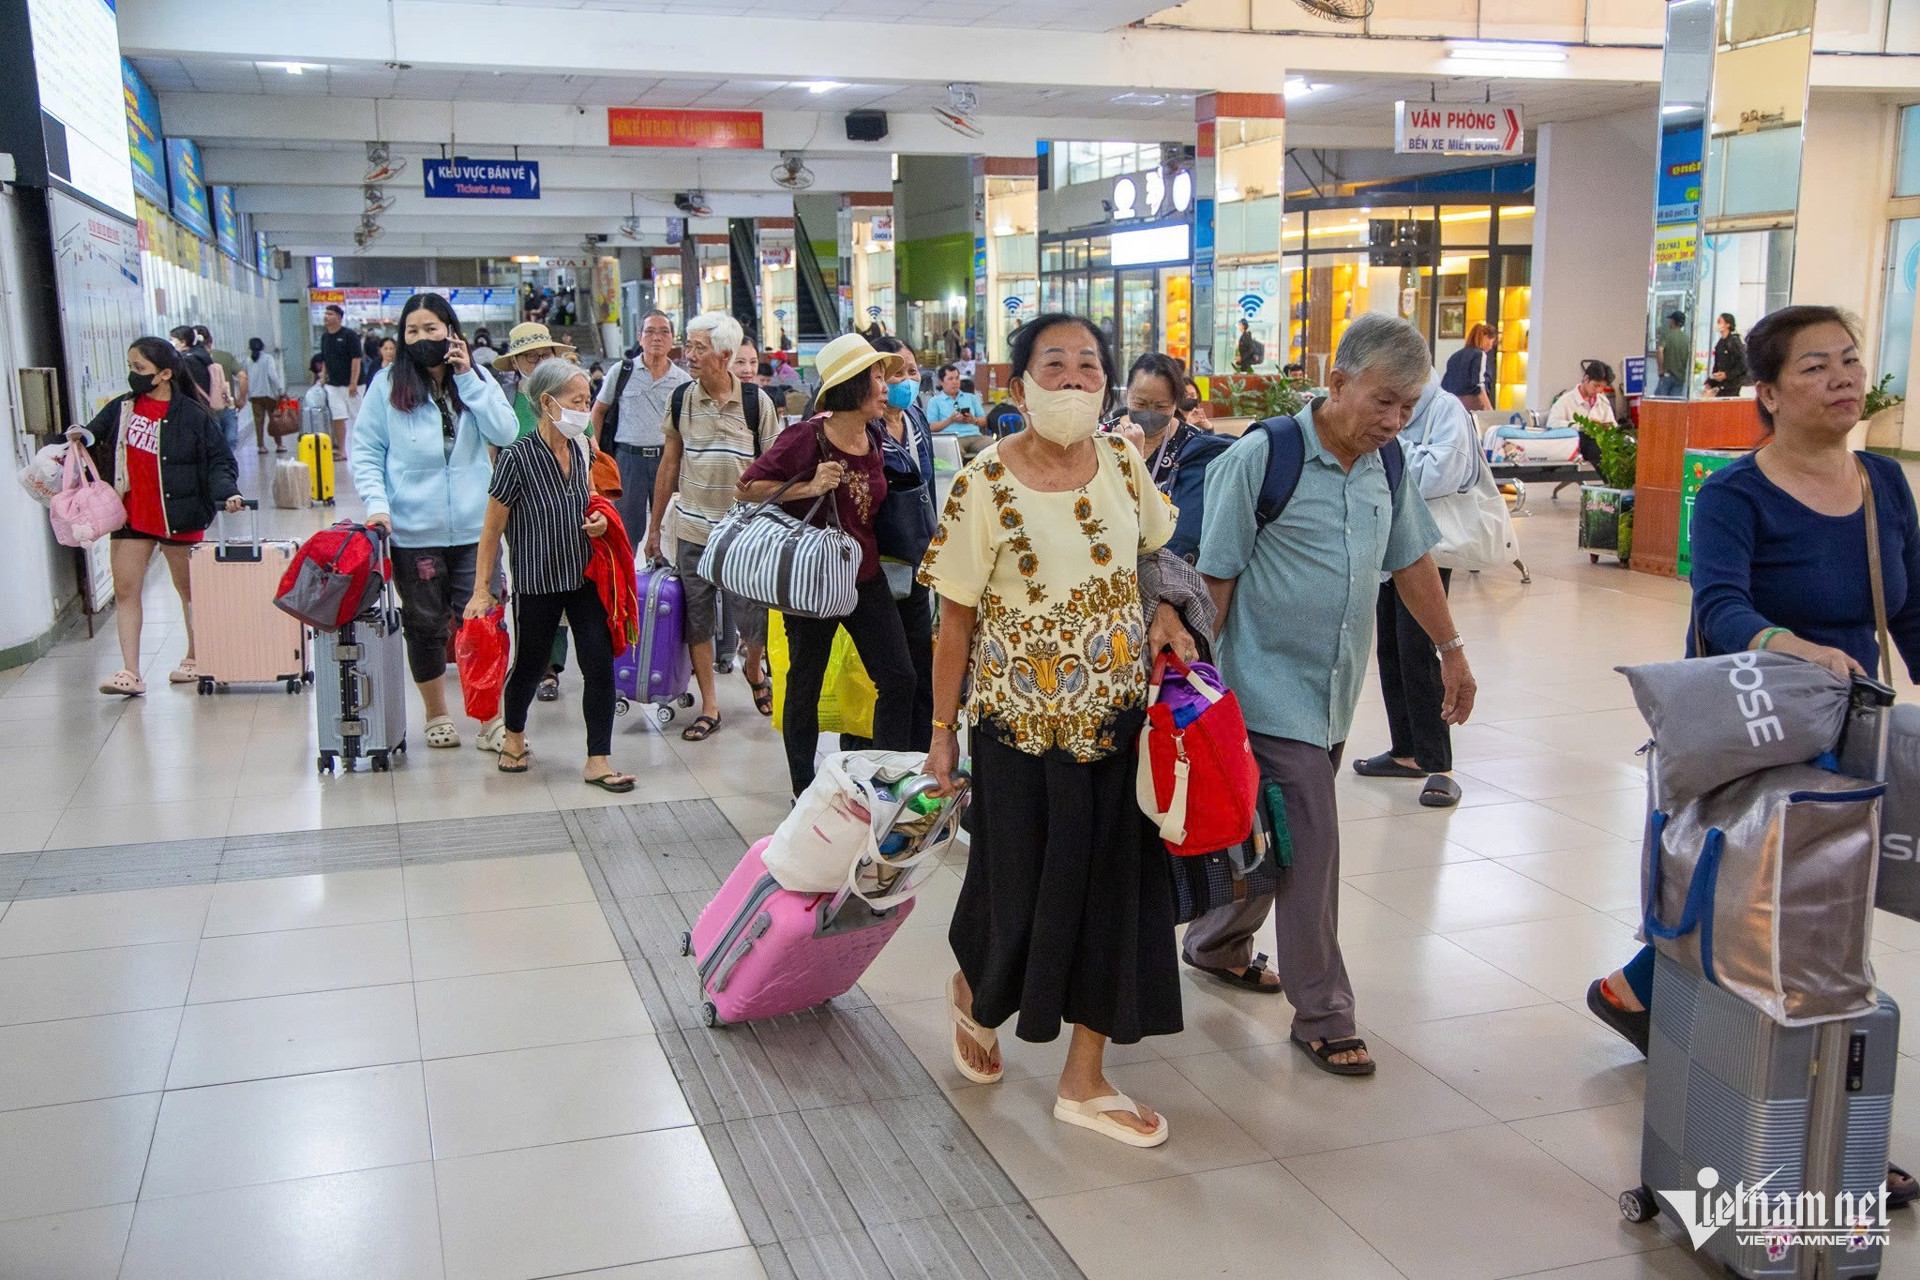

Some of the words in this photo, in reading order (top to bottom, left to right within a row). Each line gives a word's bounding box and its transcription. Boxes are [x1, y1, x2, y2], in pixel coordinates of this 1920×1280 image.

[1411, 108, 1441, 128] VĂN
[1447, 109, 1496, 130] PHÒNG
[1409, 134, 1428, 149] BẾN
[1432, 139, 1445, 149] XE
[438, 166, 462, 178] KHU
[463, 166, 486, 181] VỰC
[487, 165, 510, 179] BÁN
[456, 184, 488, 193] Tickets
[490, 185, 511, 194] Area
